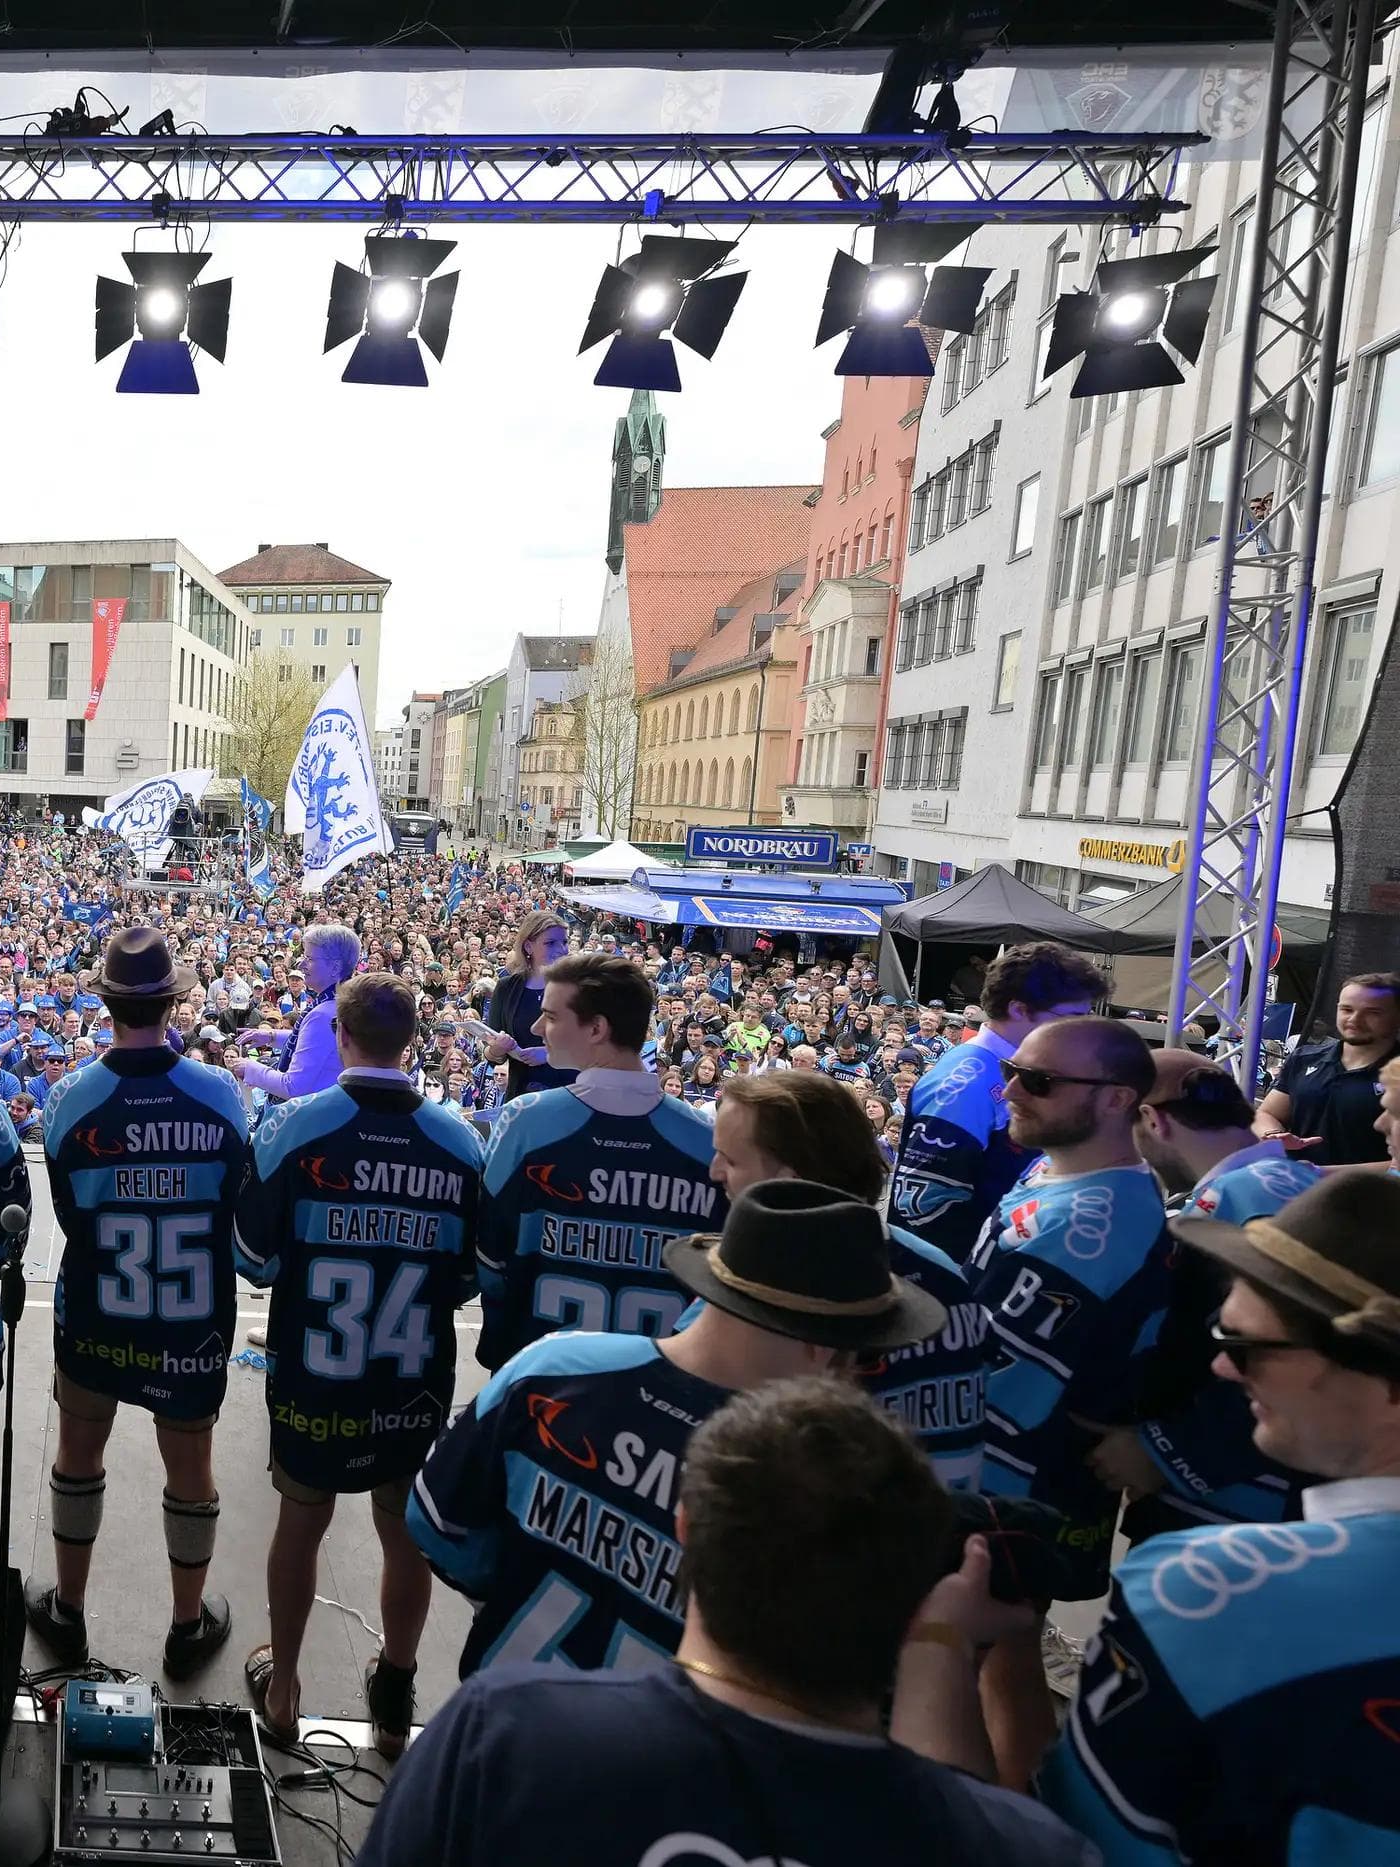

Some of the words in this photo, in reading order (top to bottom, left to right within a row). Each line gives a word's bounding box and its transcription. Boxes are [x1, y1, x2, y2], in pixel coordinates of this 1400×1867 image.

[703, 836, 819, 858] NORDBRÄU
[1077, 837, 1164, 867] COMMERZBANK
[125, 1121, 225, 1154] SATURN
[114, 1167, 187, 1200] REICH
[354, 1159, 463, 1205] SATURN
[588, 1167, 717, 1219] SATURN
[326, 1206, 440, 1251] GARTEIG
[96, 1211, 214, 1323] 35
[303, 1256, 436, 1380] 34
[74, 1336, 224, 1375] zieglerhaus
[274, 1400, 433, 1442] zieglerhaus
[525, 1470, 686, 1623] MARSH
